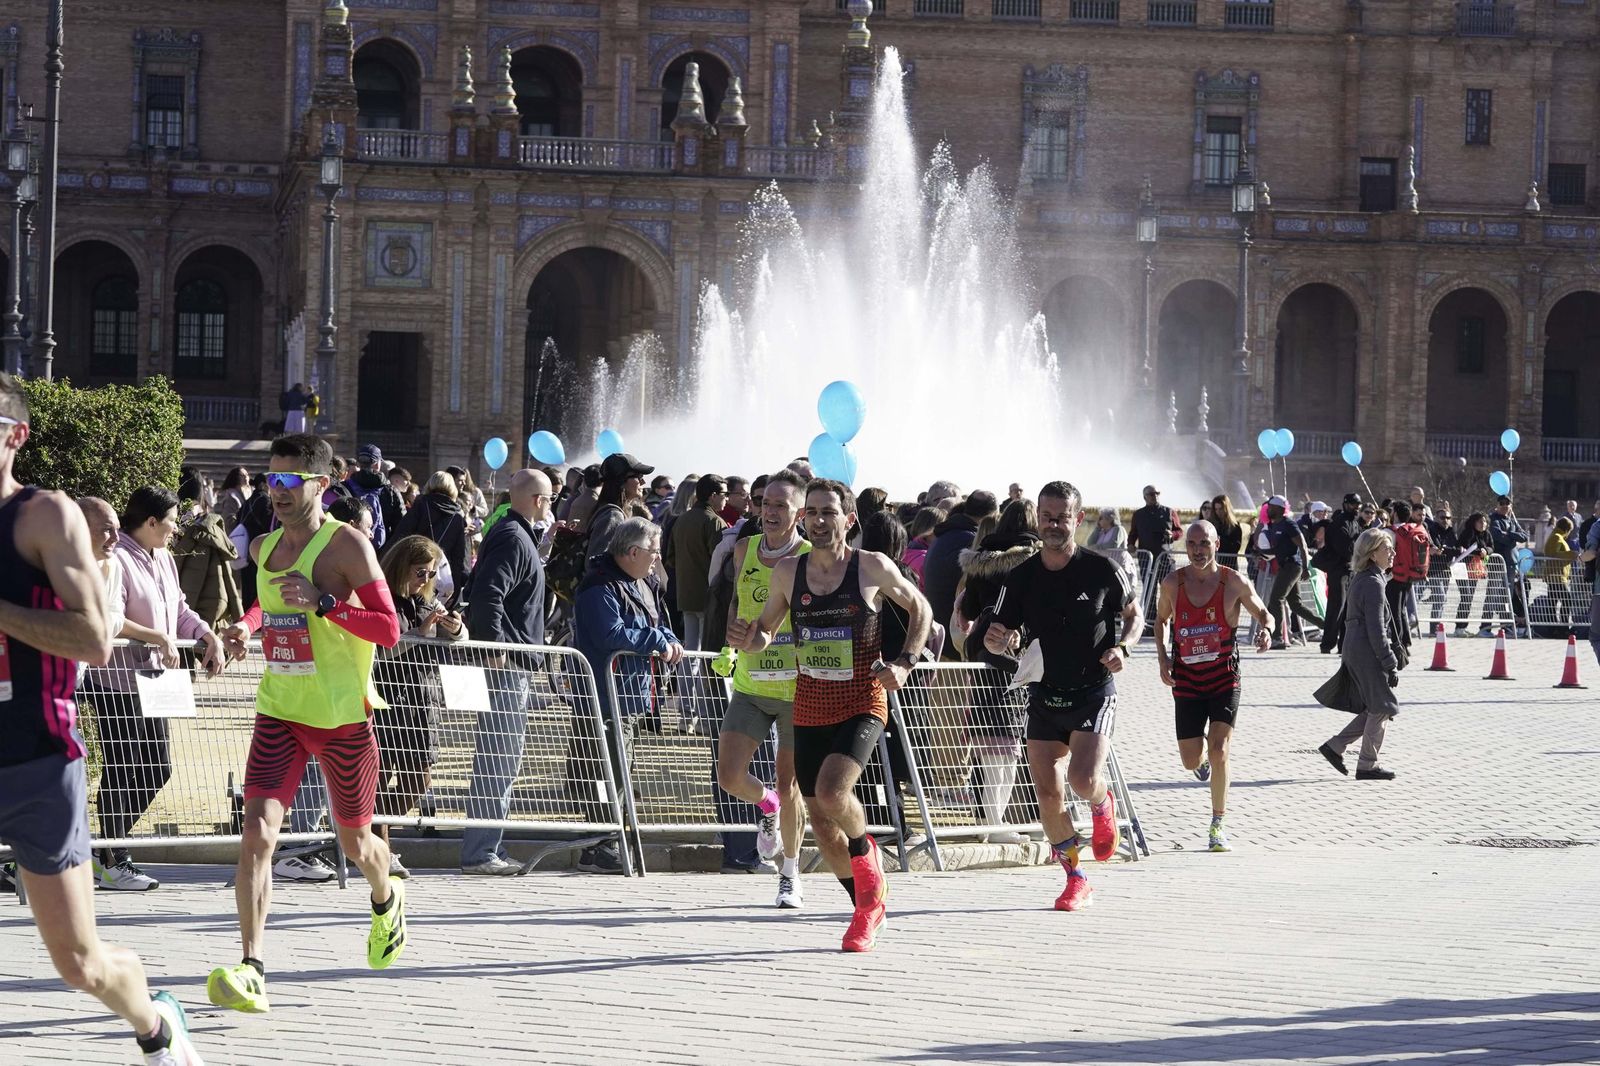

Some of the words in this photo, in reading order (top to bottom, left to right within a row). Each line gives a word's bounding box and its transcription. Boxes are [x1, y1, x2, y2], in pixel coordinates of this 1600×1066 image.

[813, 630, 845, 639] ZURICH
[1190, 626, 1214, 634] ZURICH
[272, 646, 295, 660] RUBI
[1192, 645, 1208, 655] EIRE
[759, 659, 784, 669] LOLO
[806, 656, 841, 668] ARCOS
